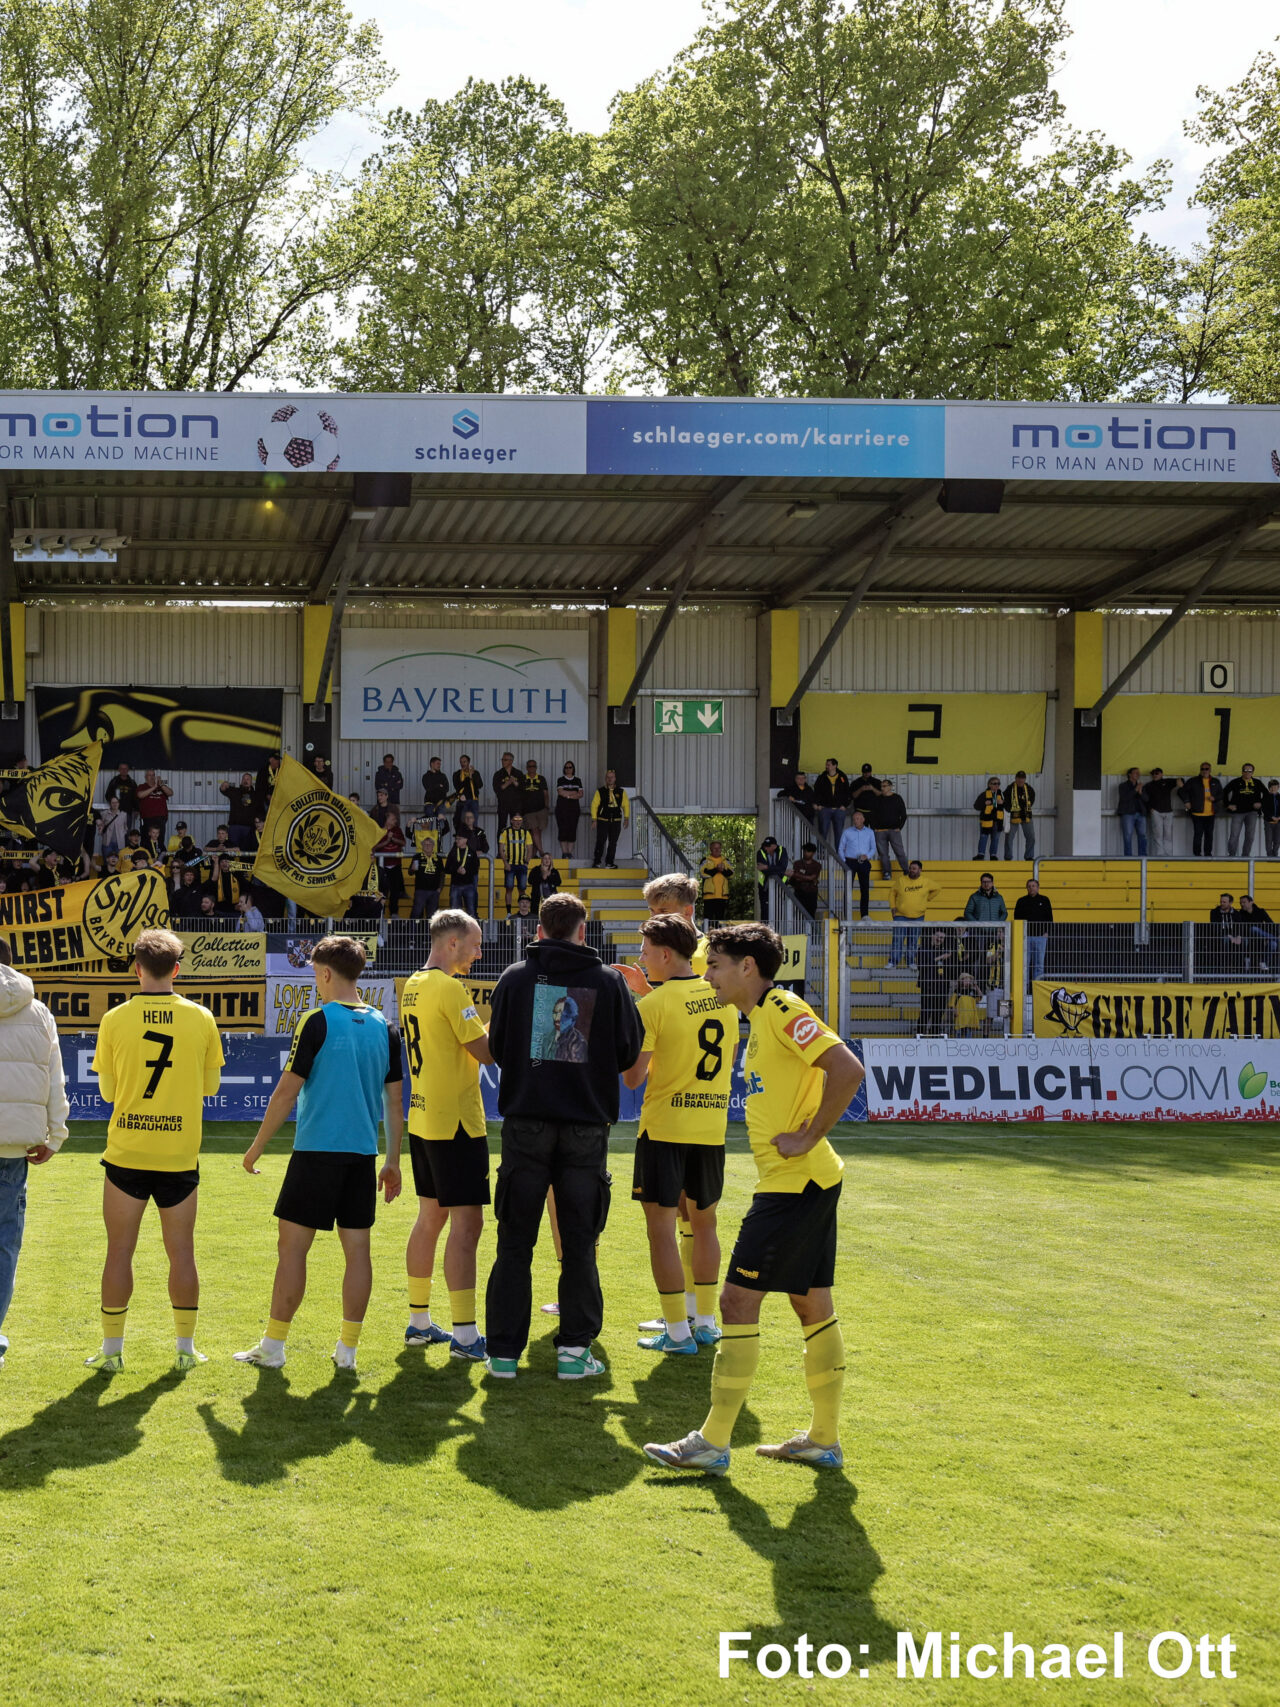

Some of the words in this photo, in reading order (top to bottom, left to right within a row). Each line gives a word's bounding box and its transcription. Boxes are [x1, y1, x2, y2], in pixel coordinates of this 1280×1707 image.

[632, 426, 910, 449] schlaeger.com/karriere
[1012, 416, 1236, 450] motion
[33, 445, 75, 460] MAN
[84, 446, 123, 460] AND
[134, 446, 218, 461] MACHINE
[415, 444, 517, 464] schlaeger
[1012, 455, 1046, 470] FOR
[1056, 456, 1096, 471] MAN
[1105, 457, 1143, 471] AND
[1153, 457, 1236, 473] MACHINE
[363, 688, 568, 723] BAYREUTH
[906, 704, 942, 765] 2
[1215, 708, 1232, 765] 1
[307, 872, 337, 885] SEMPRE
[9, 924, 85, 965] LEBEN
[89, 916, 136, 956] BAYREU
[191, 936, 260, 955] Collettivo
[191, 955, 228, 971] Giallo
[233, 955, 261, 968] Nero
[274, 984, 313, 1009] LOVE
[143, 1009, 173, 1024] HEIM
[1092, 995, 1193, 1038] GELBE
[696, 1018, 725, 1081] 8
[869, 1041, 919, 1057] Immer
[926, 1040, 940, 1057] in
[947, 1040, 1044, 1060] Bewegung.
[1050, 1040, 1109, 1060] Always
[1114, 1043, 1136, 1057] on
[1143, 1040, 1169, 1057] the
[1175, 1043, 1226, 1057] move.
[142, 1030, 174, 1099] 7
[127, 1121, 182, 1131] BRAUHAUS
[128, 1113, 182, 1123] BAYREUTHER
